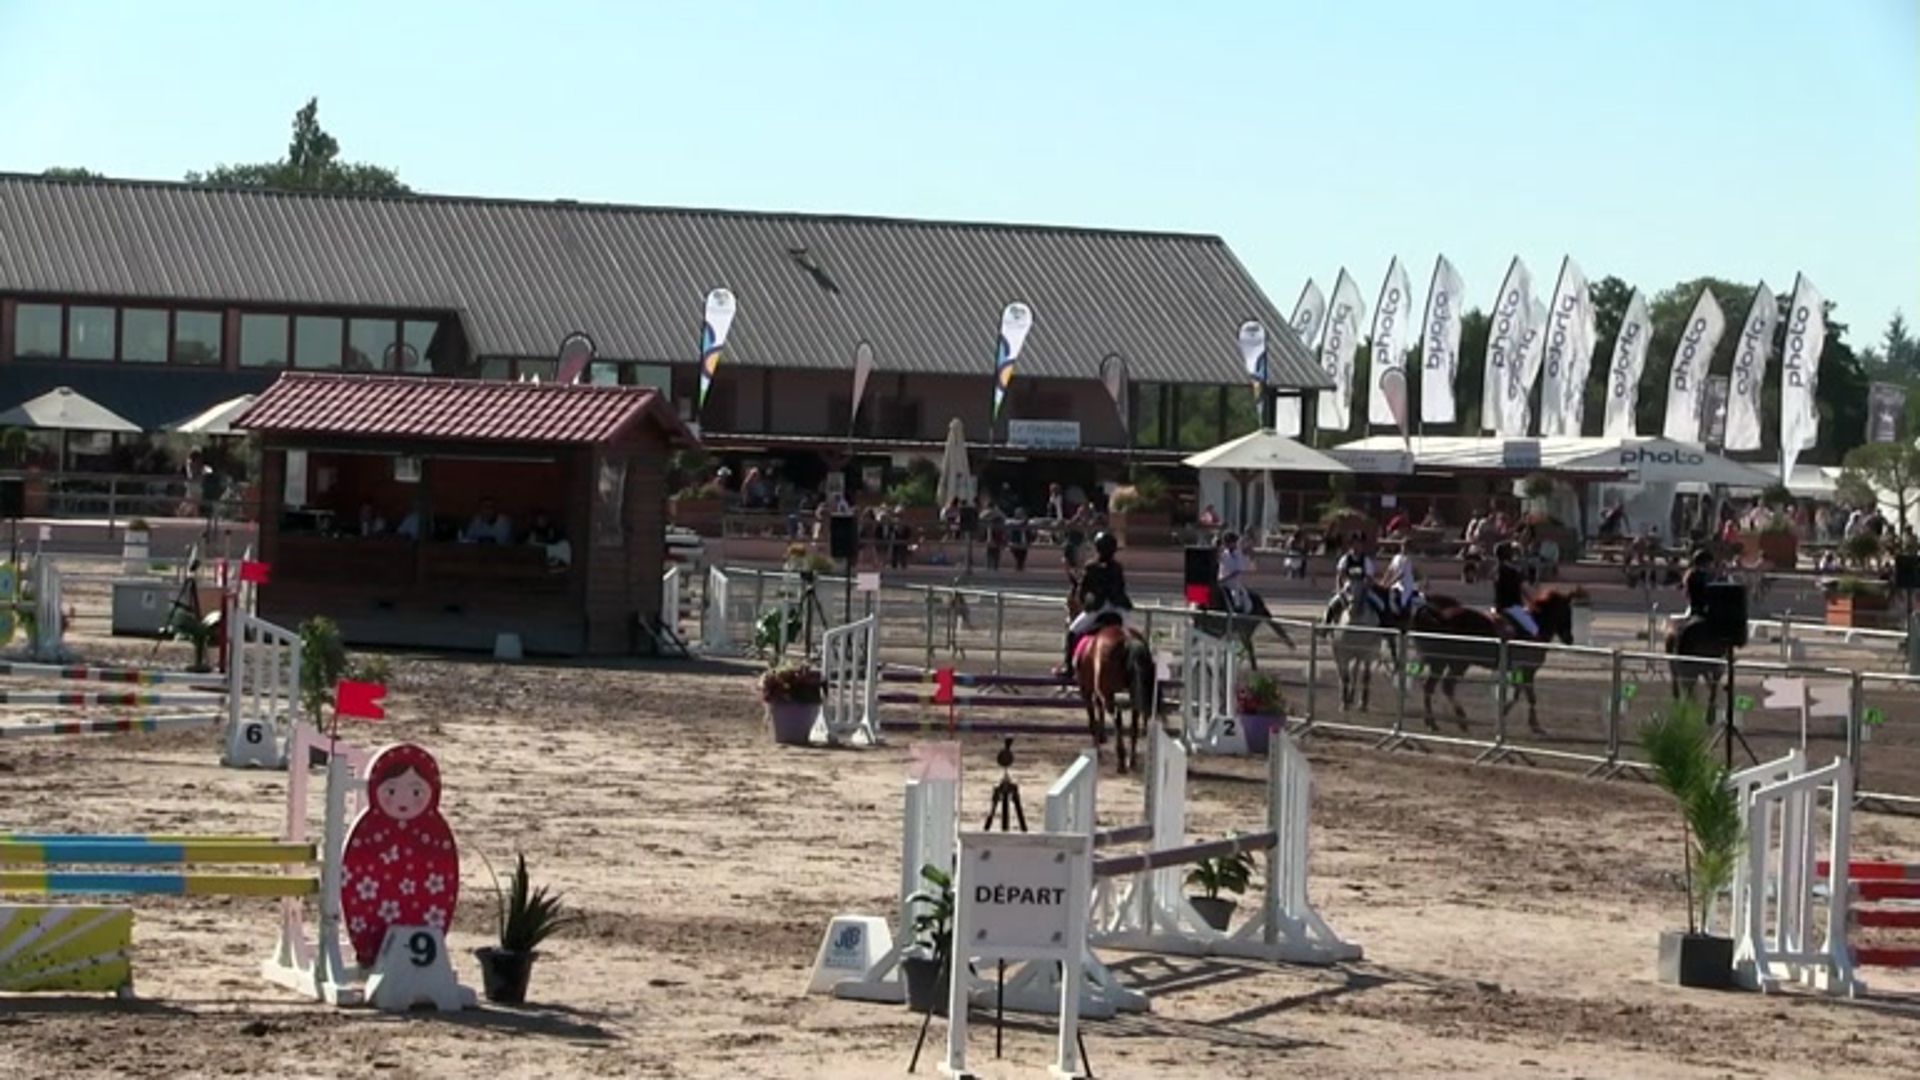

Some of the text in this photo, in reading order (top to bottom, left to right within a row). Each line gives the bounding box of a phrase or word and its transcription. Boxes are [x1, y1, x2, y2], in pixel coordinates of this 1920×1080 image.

[1376, 288, 1400, 364] photo
[1490, 290, 1519, 367] photo
[1675, 318, 1706, 391] photo
[1785, 306, 1809, 387] photo
[1620, 447, 1703, 464] photo
[246, 724, 262, 743] 6
[1223, 720, 1236, 736] 2
[975, 883, 1065, 905] DÉPART
[409, 932, 436, 966] 9
